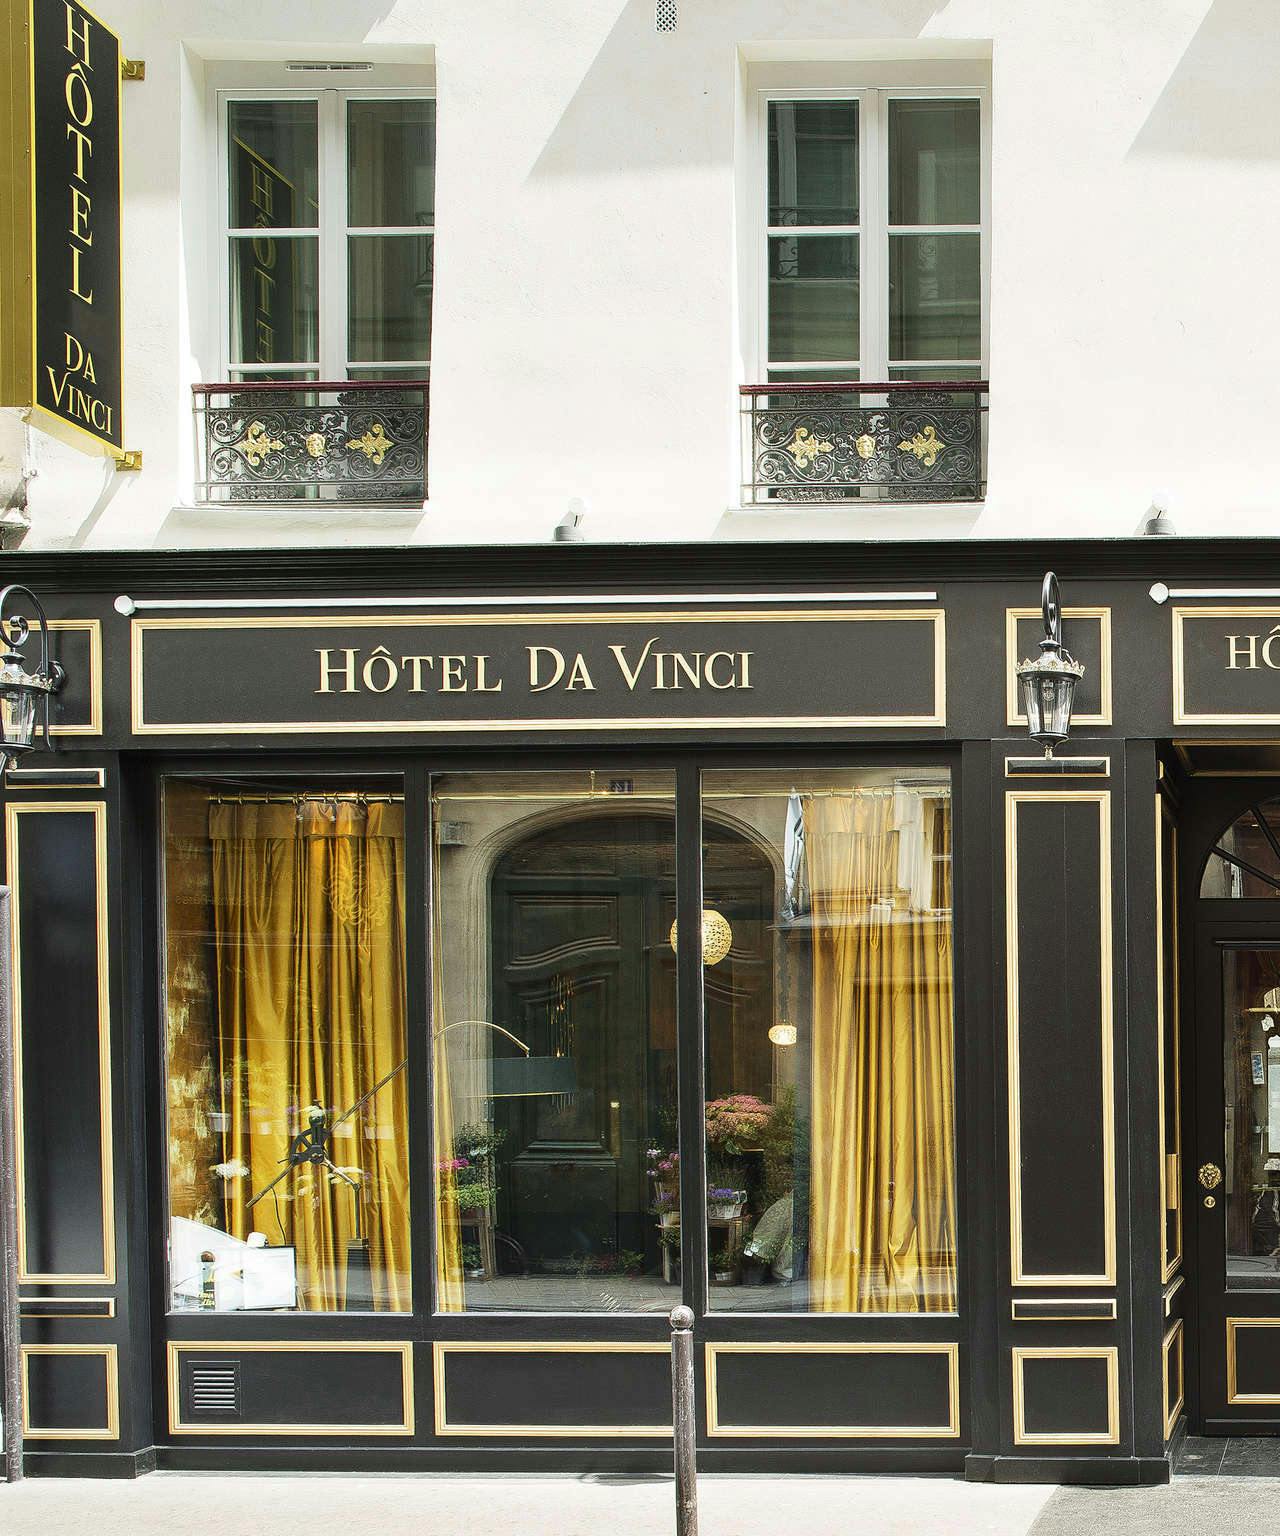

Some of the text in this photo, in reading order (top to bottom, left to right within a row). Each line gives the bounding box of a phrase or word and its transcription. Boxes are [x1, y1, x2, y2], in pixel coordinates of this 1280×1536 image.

[62, 0, 95, 305] HÔTEL
[46, 365, 113, 436] VINCI
[313, 645, 503, 694] HÔTEL
[607, 637, 755, 692] VINCI
